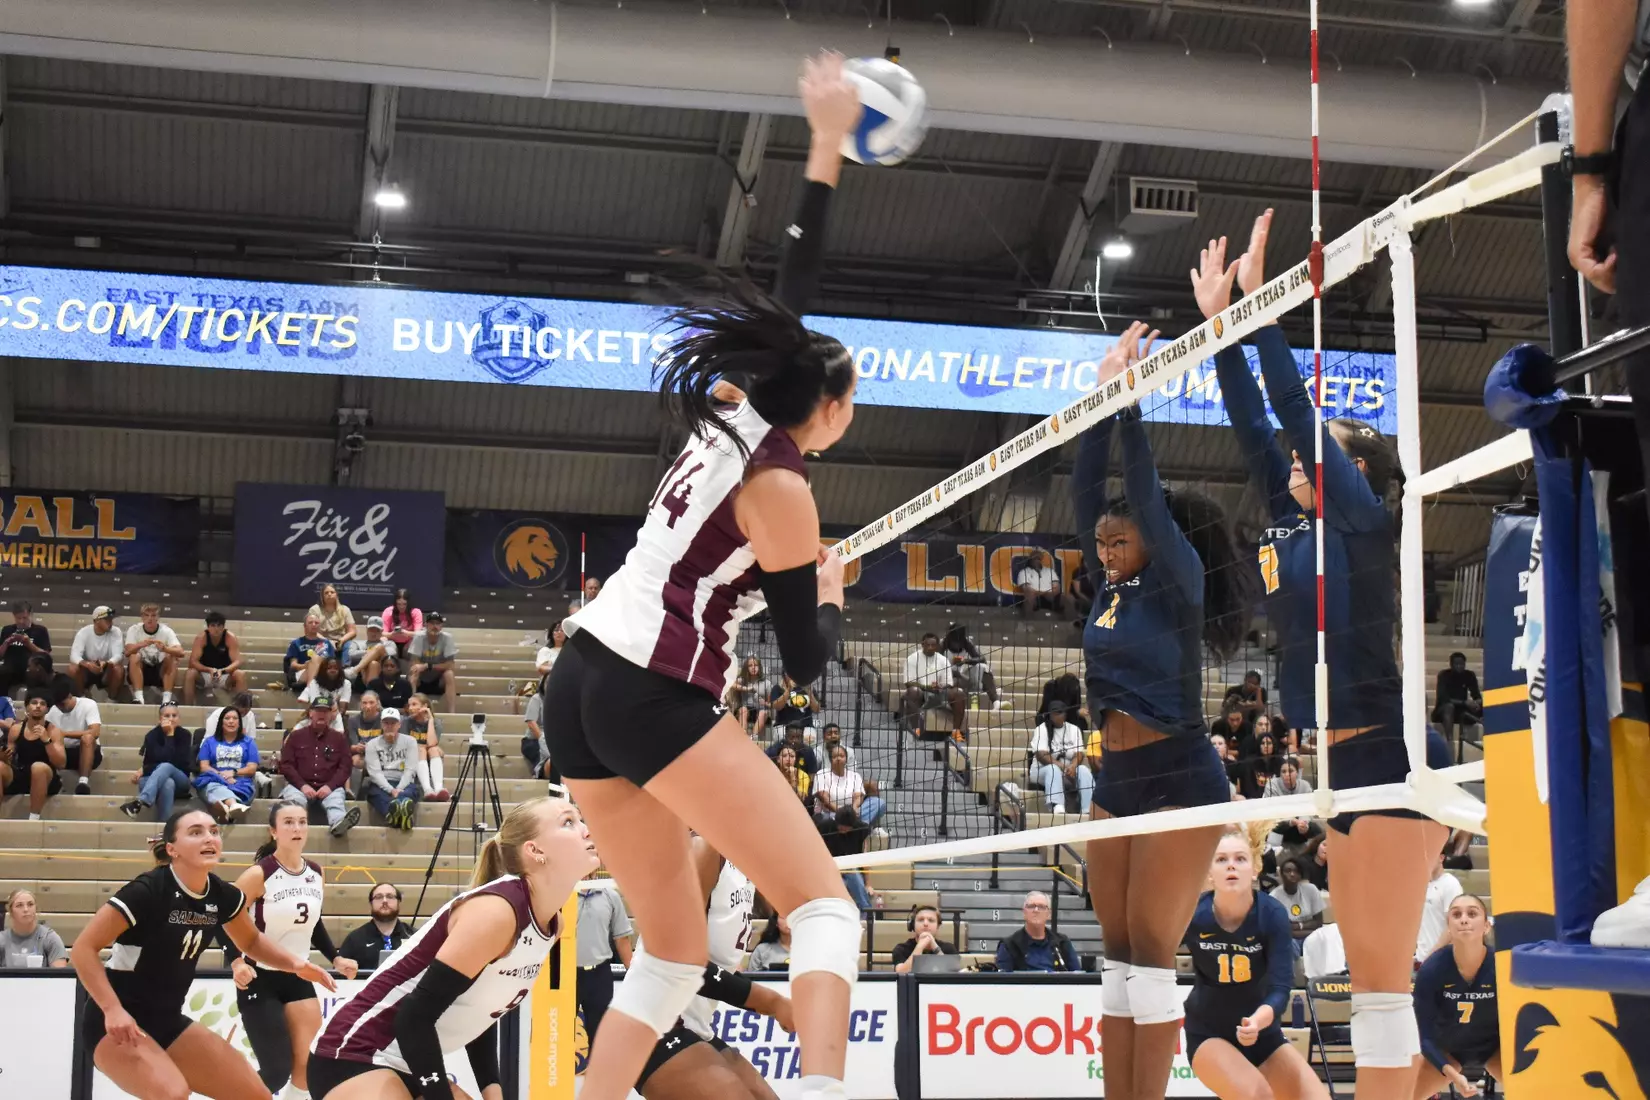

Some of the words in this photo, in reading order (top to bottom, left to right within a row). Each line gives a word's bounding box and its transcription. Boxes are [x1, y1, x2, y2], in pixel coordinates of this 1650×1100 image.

[106, 287, 179, 305] EAST
[192, 292, 284, 312] TEXAS
[1230, 301, 1253, 326] EAST
[1254, 279, 1286, 311] TEXAS
[393, 318, 482, 355] BUY
[493, 323, 675, 367] TICKETS
[847, 346, 1098, 392] ONATHLETIC
[1140, 356, 1160, 380] EAST
[1160, 340, 1188, 366] TEXAS
[1063, 403, 1082, 424] EAST
[1082, 392, 1104, 413] TEXAS
[648, 450, 704, 530] 14
[0, 495, 137, 540] ALL
[282, 500, 350, 546] Fix
[348, 503, 391, 555] &
[1267, 520, 1310, 539] TEXS
[0, 542, 118, 571] MERICANS
[298, 541, 398, 587] Feed
[293, 902, 309, 925] 3
[180, 929, 203, 960] 11
[1199, 942, 1229, 951] EAST
[1232, 942, 1264, 953] TEXAS
[1217, 953, 1252, 983] 18
[1464, 991, 1495, 1000] TEXAS
[1456, 1001, 1475, 1023] 7
[928, 1003, 1103, 1056] Brook
